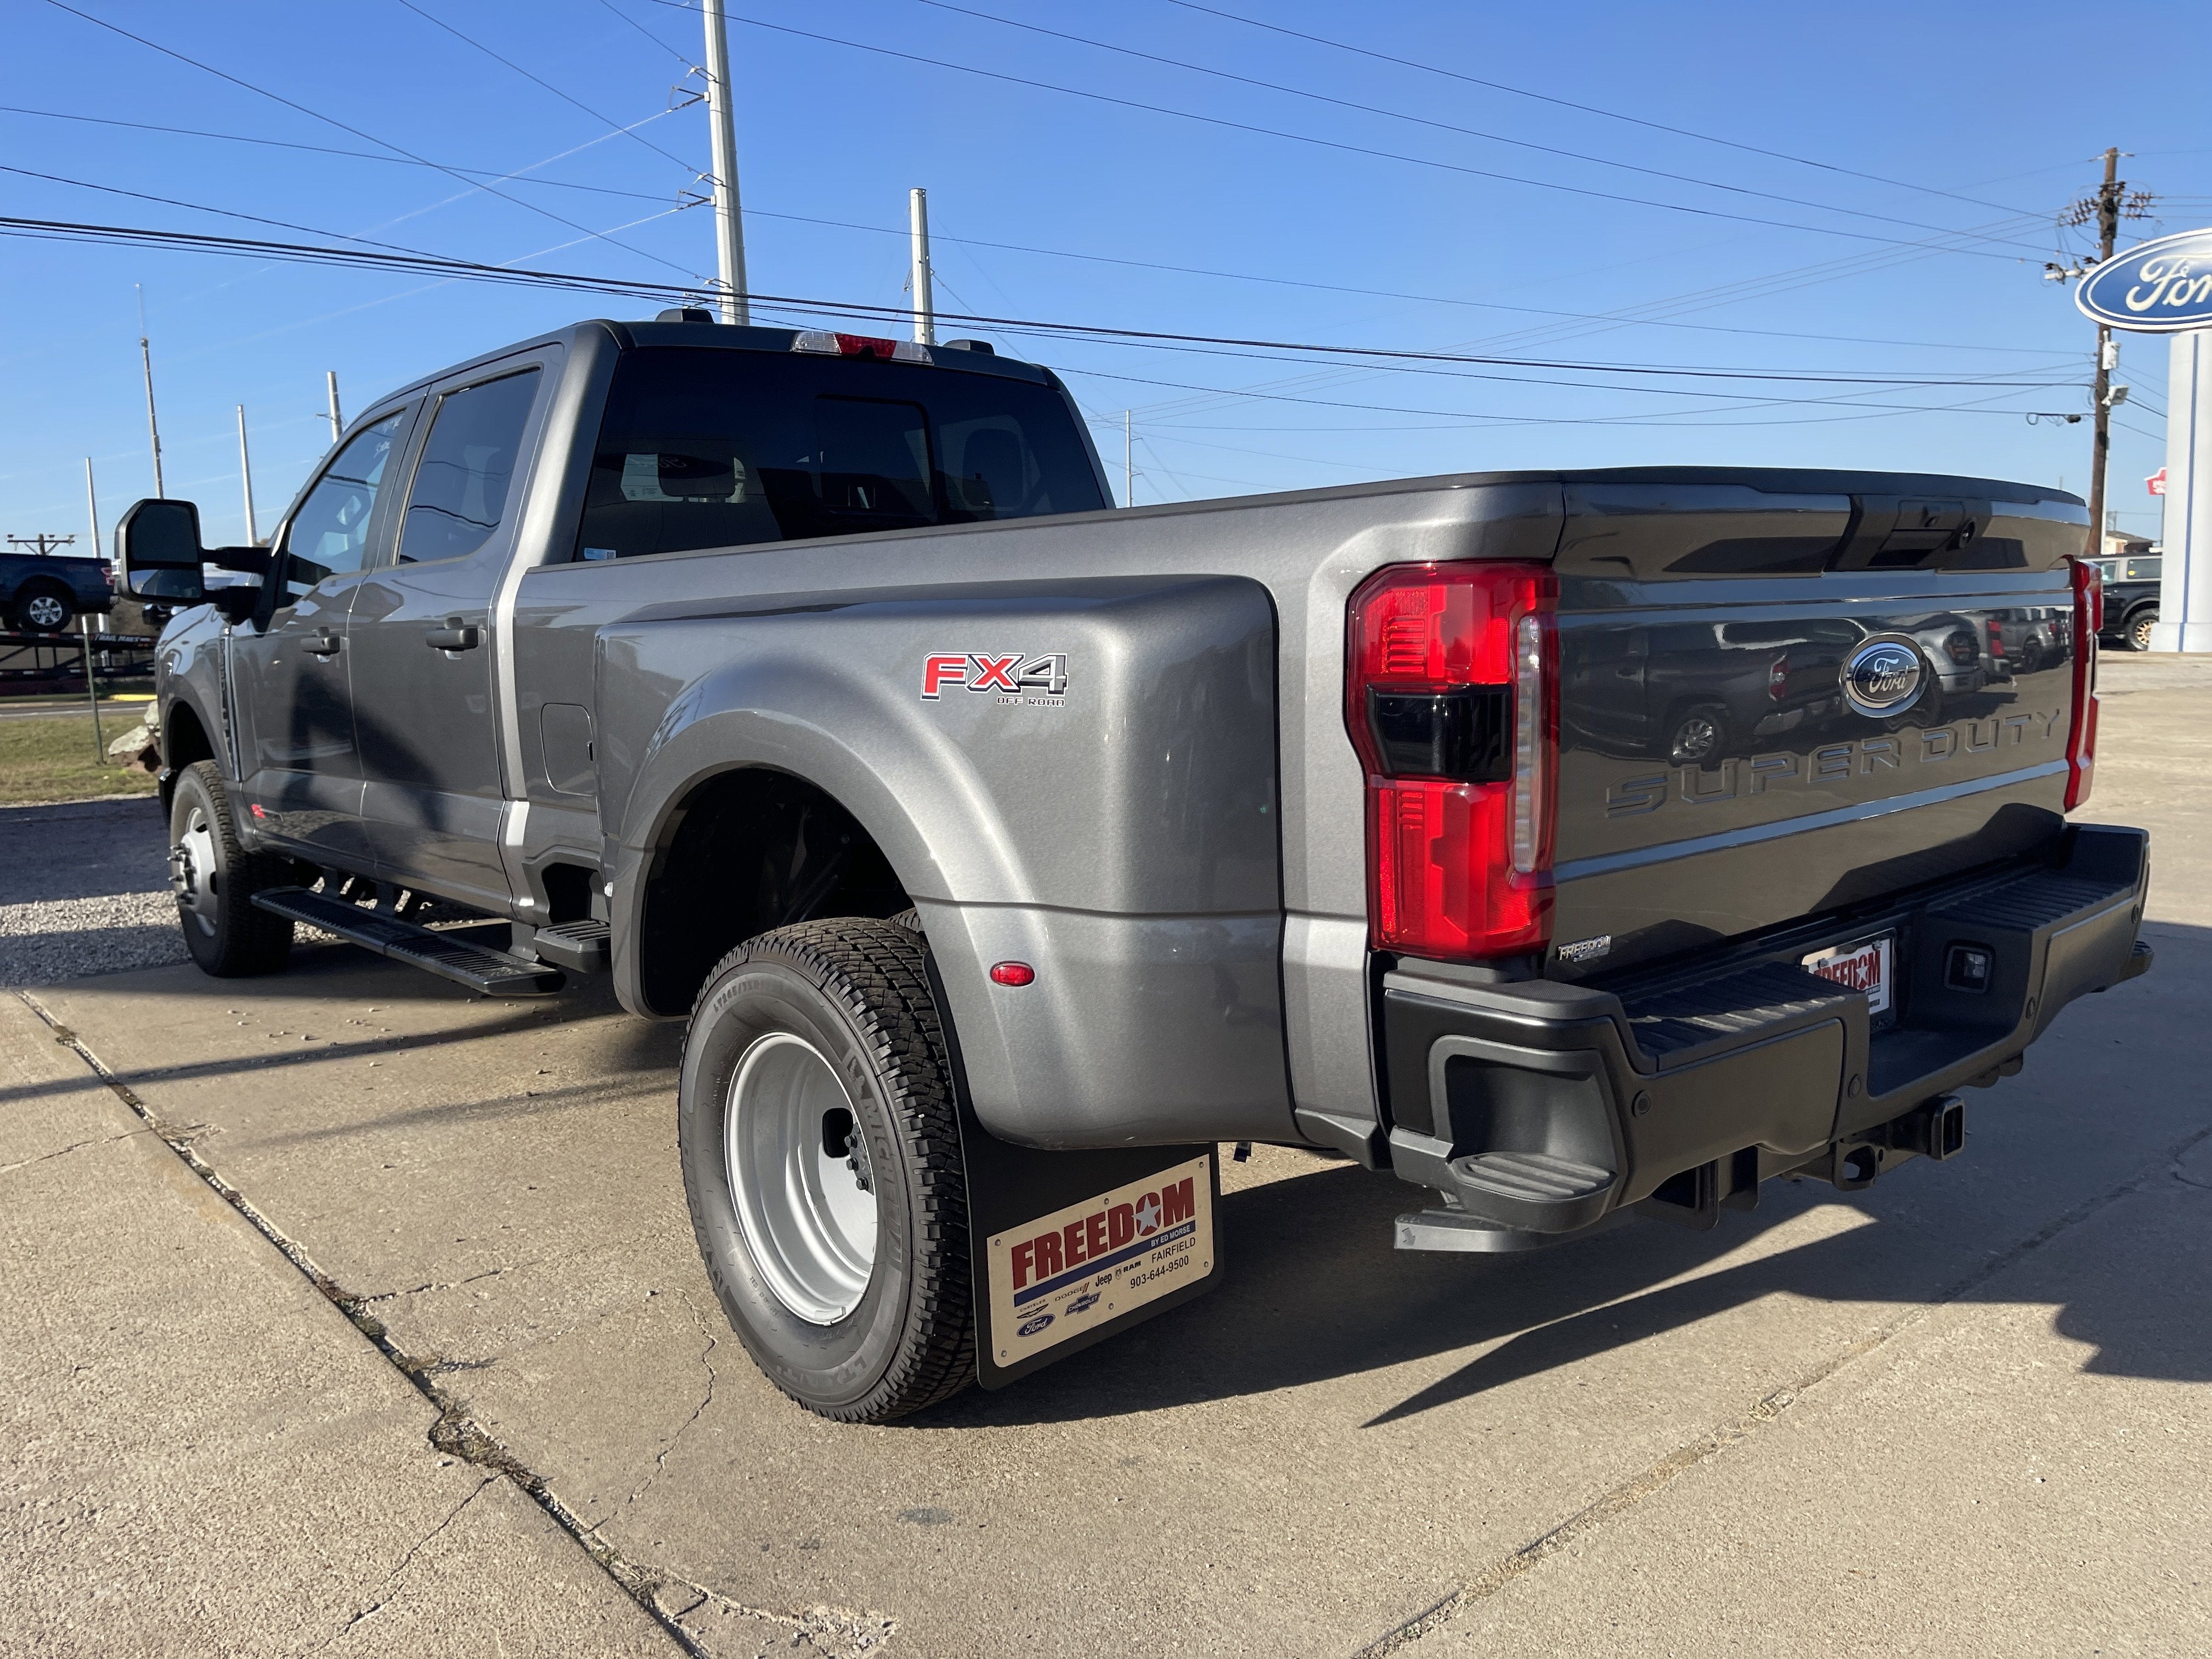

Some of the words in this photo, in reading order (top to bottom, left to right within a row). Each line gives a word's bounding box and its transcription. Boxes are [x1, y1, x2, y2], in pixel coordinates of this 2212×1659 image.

[2125, 254, 2212, 312] For
[920, 651, 1069, 702] FX4
[1869, 657, 1909, 693] Ford
[996, 696, 1024, 706] OFF
[1028, 697, 1066, 708] ROAD
[1605, 735, 1903, 819] SUPER
[1920, 708, 2061, 764] DUTY
[1558, 935, 1612, 961] FREEDOM
[1814, 950, 1881, 990] EEDOM
[861, 1097, 902, 1264] MICHELIN
[1011, 1177, 1195, 1290] FREEDOM
[1150, 1238, 1159, 1247] BY
[1160, 1234, 1169, 1244] ED
[1169, 1225, 1191, 1239] MORSE
[1152, 1237, 1196, 1263] FAIRFIELD
[1123, 1260, 1142, 1273] RAM
[1130, 1255, 1189, 1289] 903-644-9500
[1095, 1273, 1112, 1287] Jeep
[1019, 1299, 1046, 1312] CHRYSLER
[1054, 1286, 1086, 1302] DODGE
[1068, 1295, 1099, 1312] CHEVROLET
[1024, 1318, 1048, 1335] Ford
